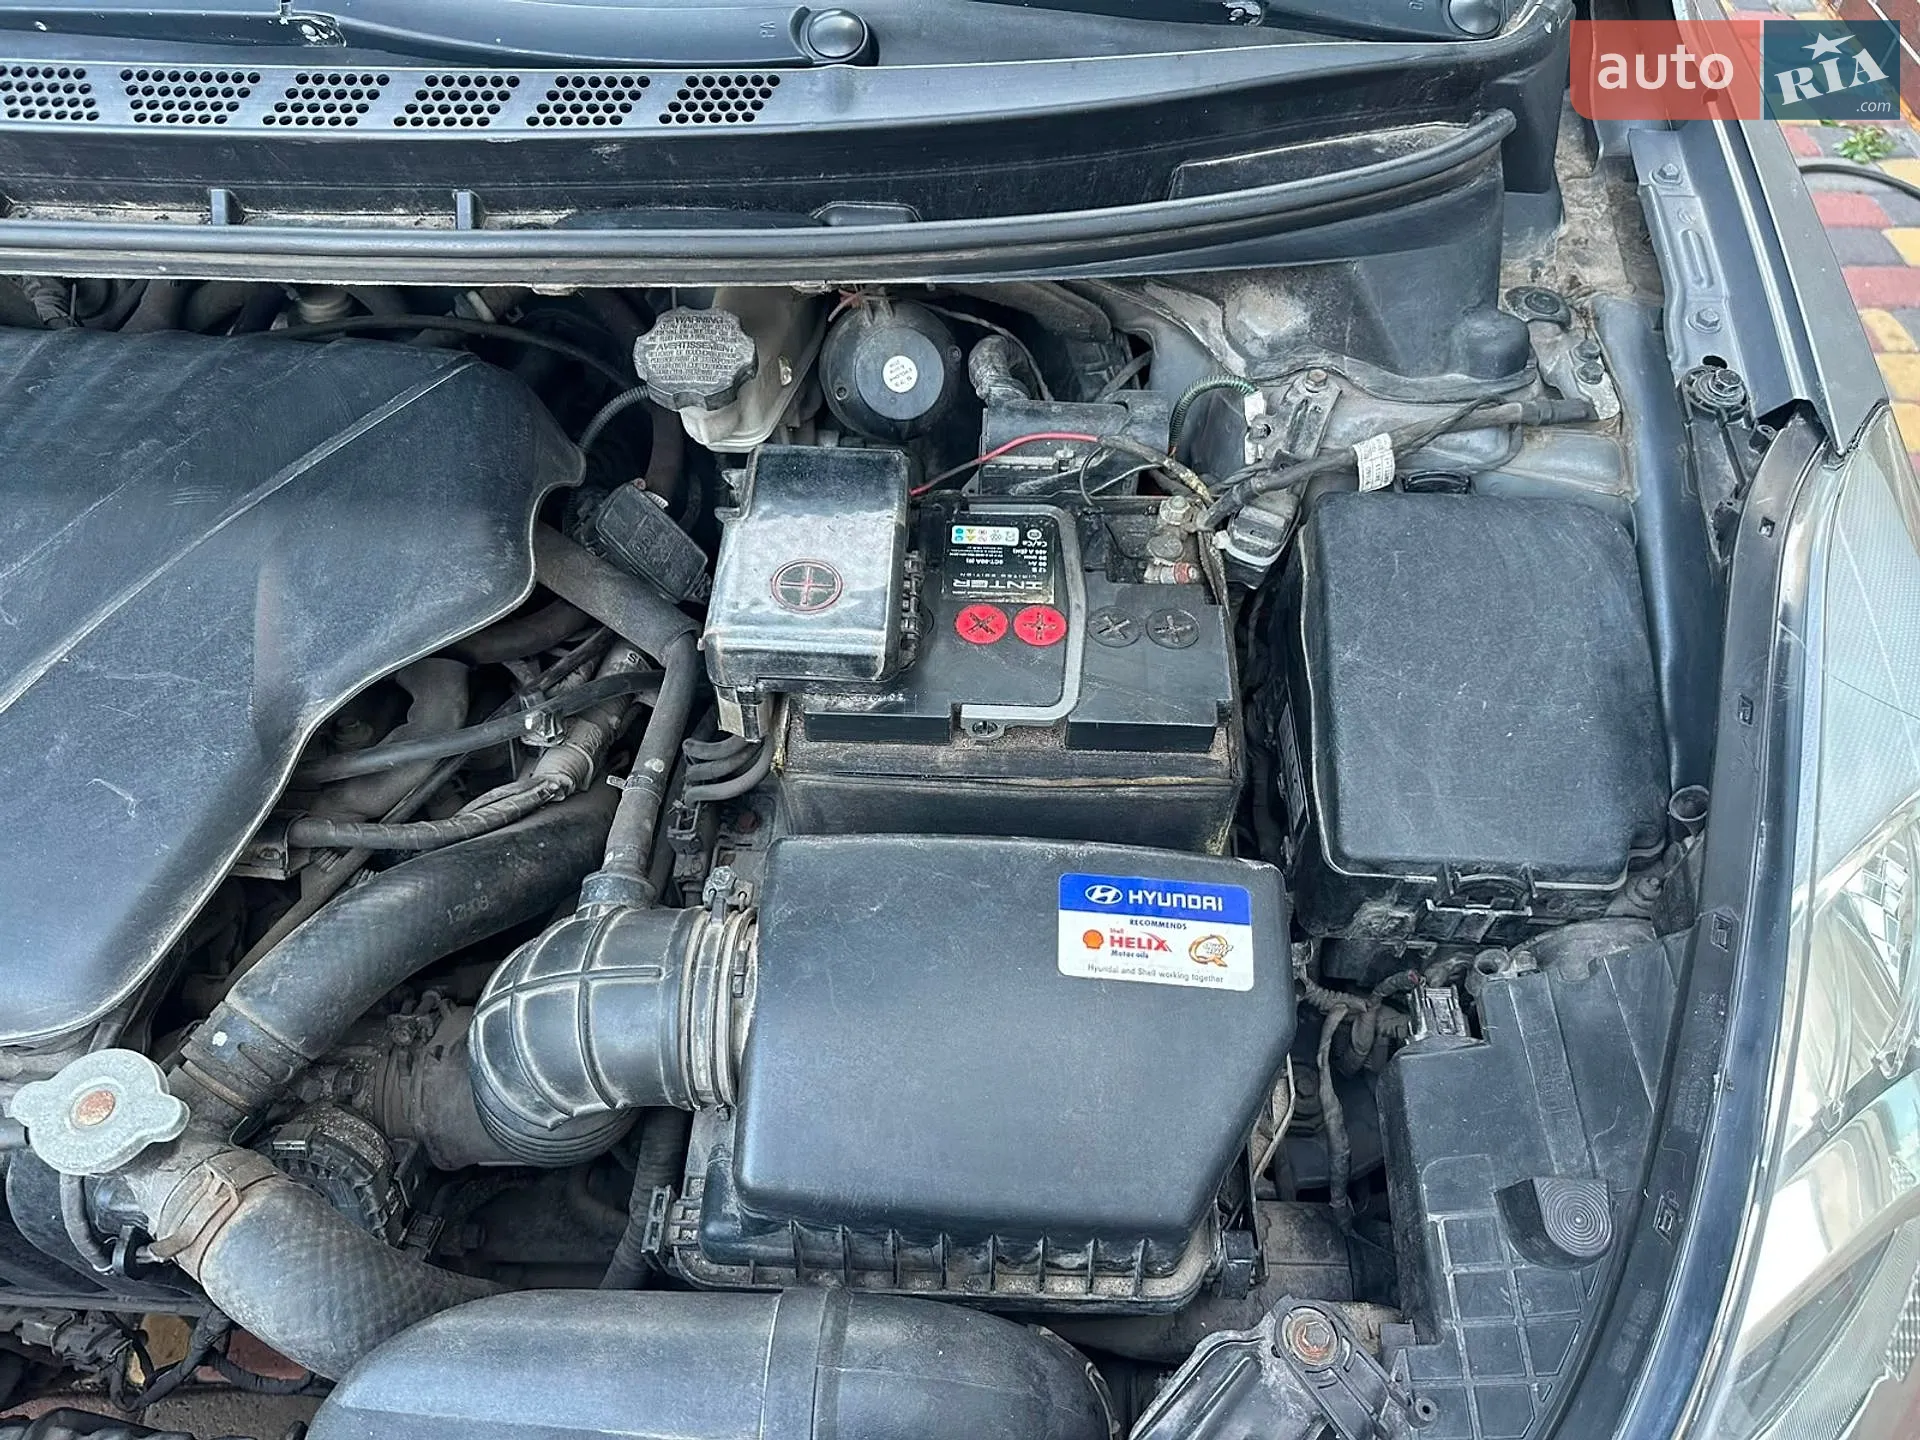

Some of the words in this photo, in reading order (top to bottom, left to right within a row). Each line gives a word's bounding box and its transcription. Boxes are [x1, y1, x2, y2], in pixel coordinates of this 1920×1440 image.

[675, 316, 724, 324] WARNING
[1022, 539, 1047, 547] Ca/Ca
[952, 579, 1042, 590] INTER
[1128, 889, 1223, 912] HYUNDAI
[1129, 918, 1187, 930] RECOMMENDS
[1109, 934, 1170, 952] HELIX
[1110, 950, 1134, 958] Motor
[1087, 963, 1119, 974] Hyundai
[1120, 965, 1136, 975] and
[1138, 967, 1156, 977] Shell
[1158, 969, 1190, 982] working
[1191, 973, 1224, 984] together
